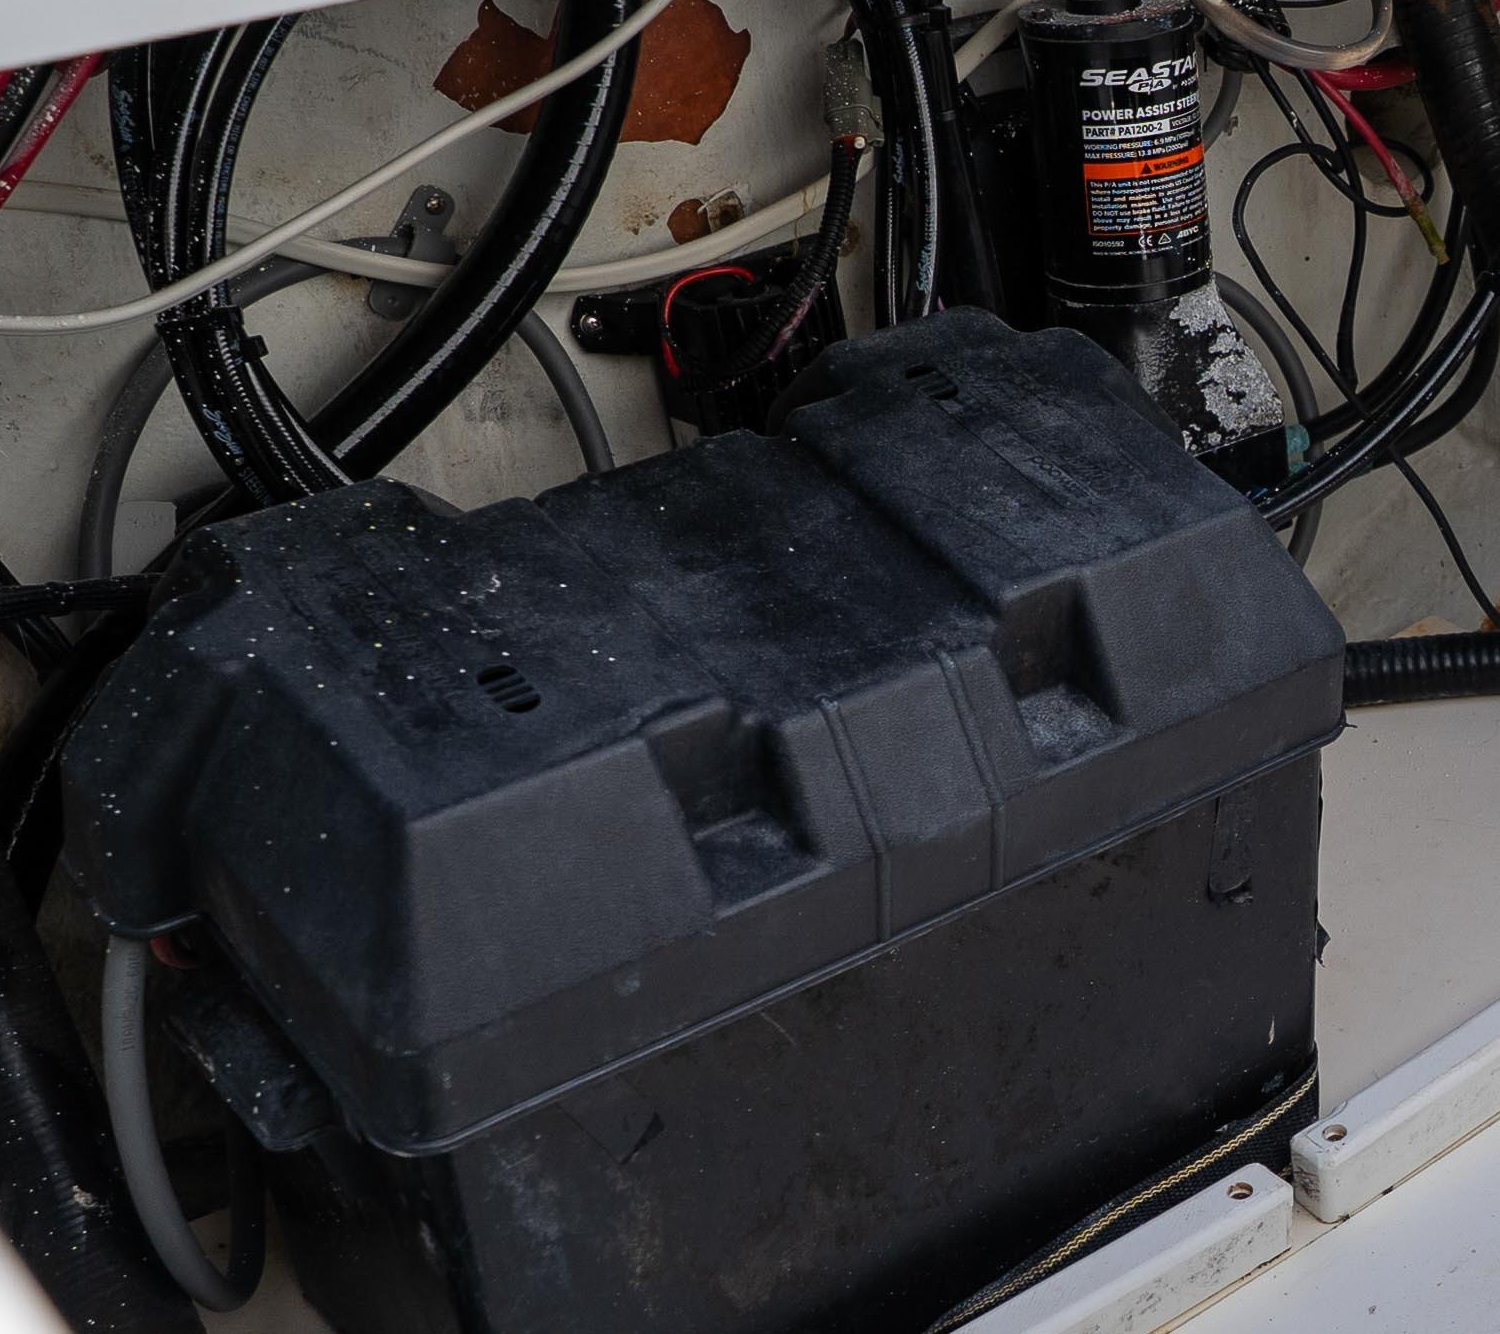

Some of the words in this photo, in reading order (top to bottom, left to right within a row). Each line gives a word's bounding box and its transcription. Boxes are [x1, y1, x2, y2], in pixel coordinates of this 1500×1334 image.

[1082, 108, 1134, 121] POWER
[1136, 100, 1175, 118] ASSIST
[1085, 127, 1116, 137] PART#
[1118, 122, 1163, 136] PA1200-2
[1118, 140, 1154, 149] PRESSURE:
[1154, 138, 1164, 146] 6.9
[1101, 151, 1137, 159] PRESSURE:
[1138, 149, 1151, 157] 13.8
[1153, 157, 1189, 171] WARNING
